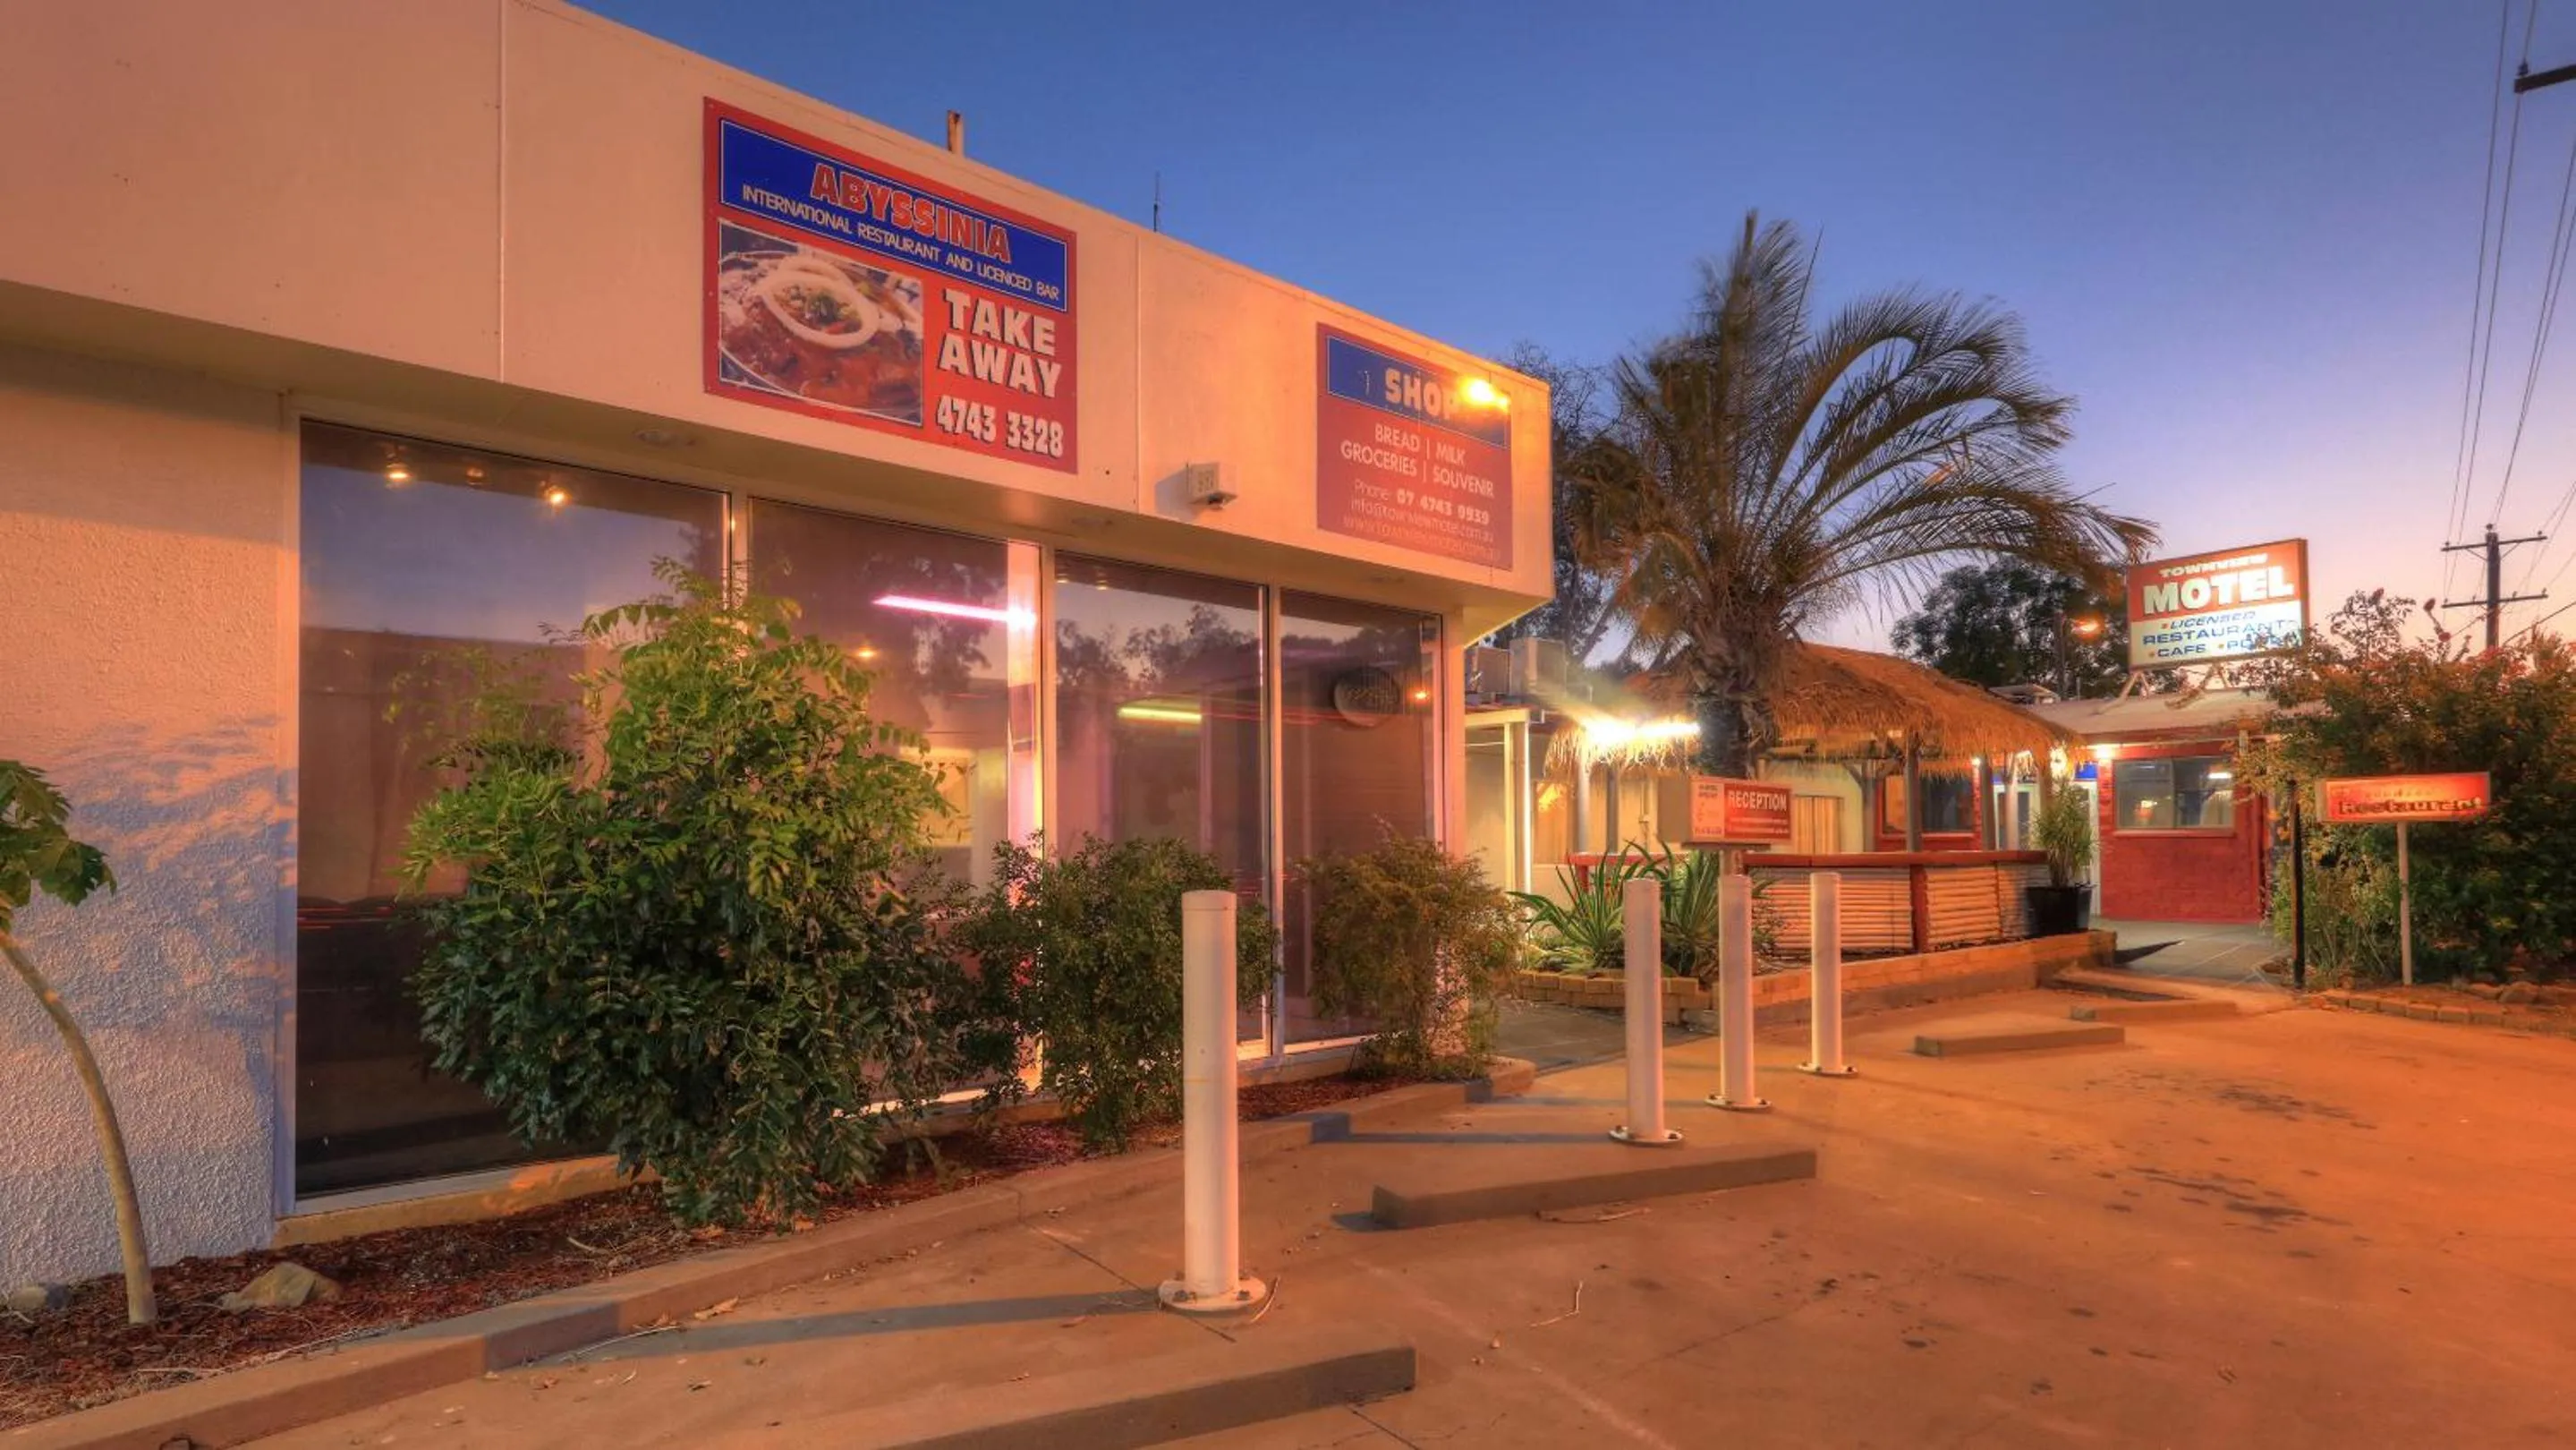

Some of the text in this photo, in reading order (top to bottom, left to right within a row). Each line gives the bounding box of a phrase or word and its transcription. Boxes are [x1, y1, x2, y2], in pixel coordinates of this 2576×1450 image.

[743, 184, 1060, 301] INTERNATIONAL RESTAURANT AND LICENCED BAR
[810, 162, 1011, 264] ABYSSINIA
[943, 288, 1056, 356] TAKE
[939, 335, 1062, 398] AWAY
[936, 396, 1064, 458] 4743 3328
[1375, 423, 1467, 466] BREAD MILK
[1341, 439, 1495, 499] GROCERIES SOUVENIR
[1397, 488, 1415, 507] 07
[1420, 495, 1452, 516] 4743
[2143, 566, 2294, 615] MOTEL
[2157, 644, 2206, 658] CAFE
[1728, 790, 1787, 811] RECEPTION
